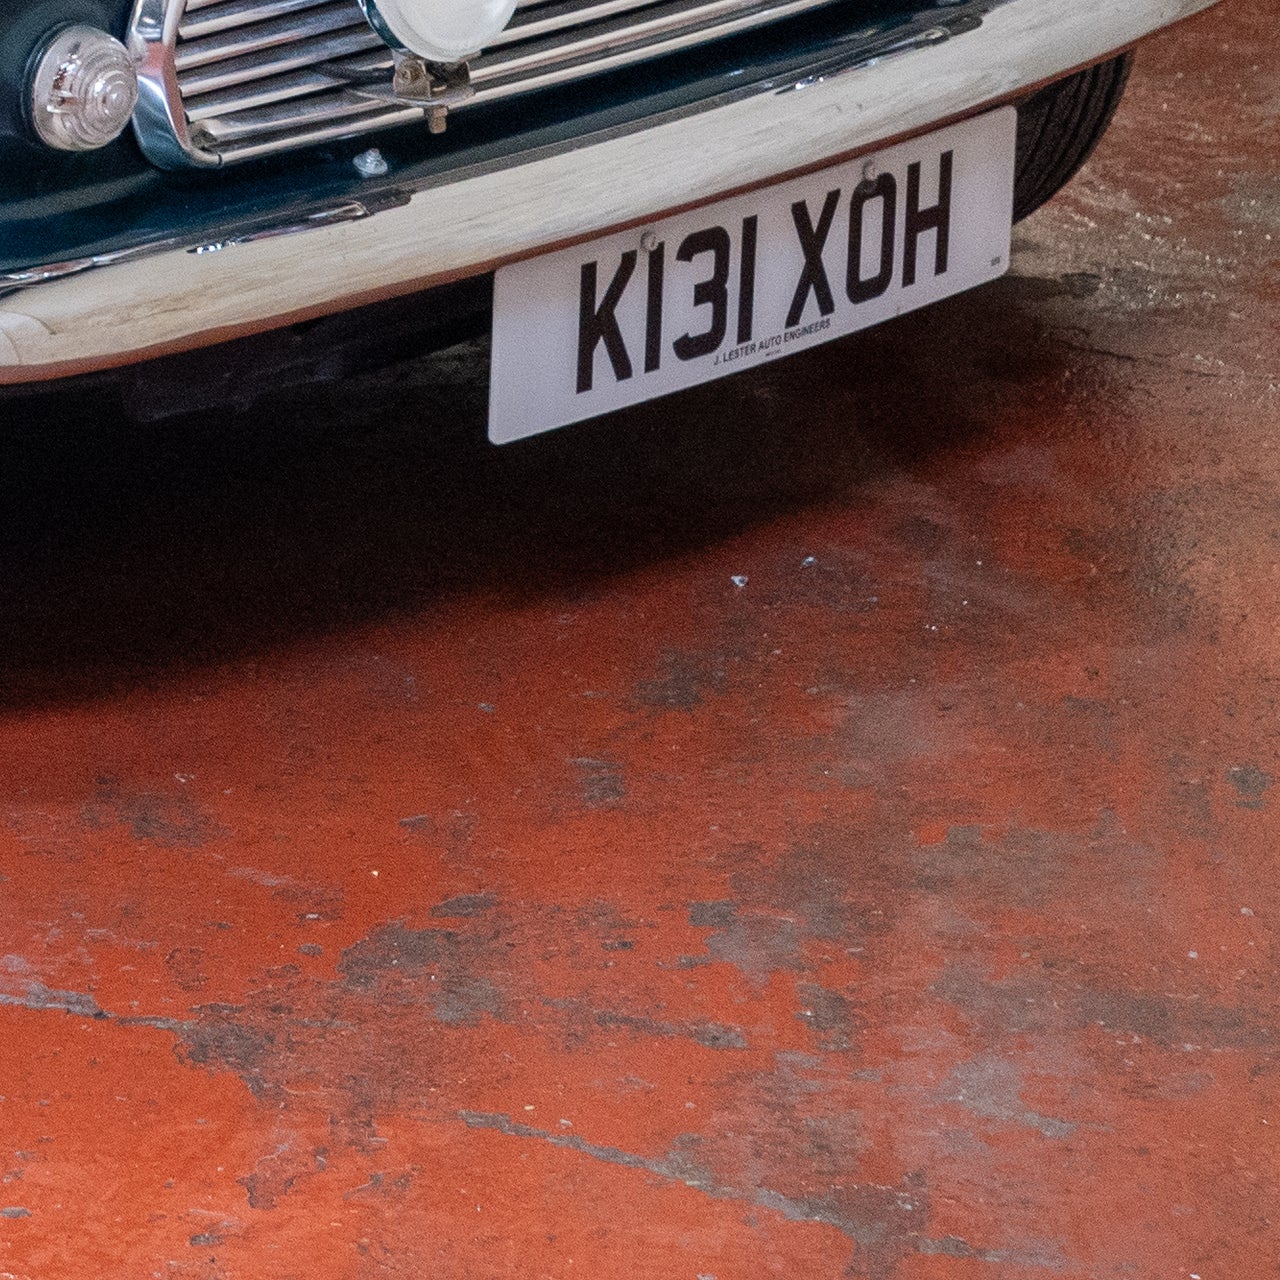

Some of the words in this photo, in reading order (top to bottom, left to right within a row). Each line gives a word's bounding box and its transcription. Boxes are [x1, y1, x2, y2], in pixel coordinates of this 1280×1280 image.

[576, 214, 758, 394] K131
[785, 150, 954, 328] XOH
[723, 343, 756, 362] LESTER
[758, 335, 782, 351] AUTO
[783, 318, 831, 342] ENGINEERS
